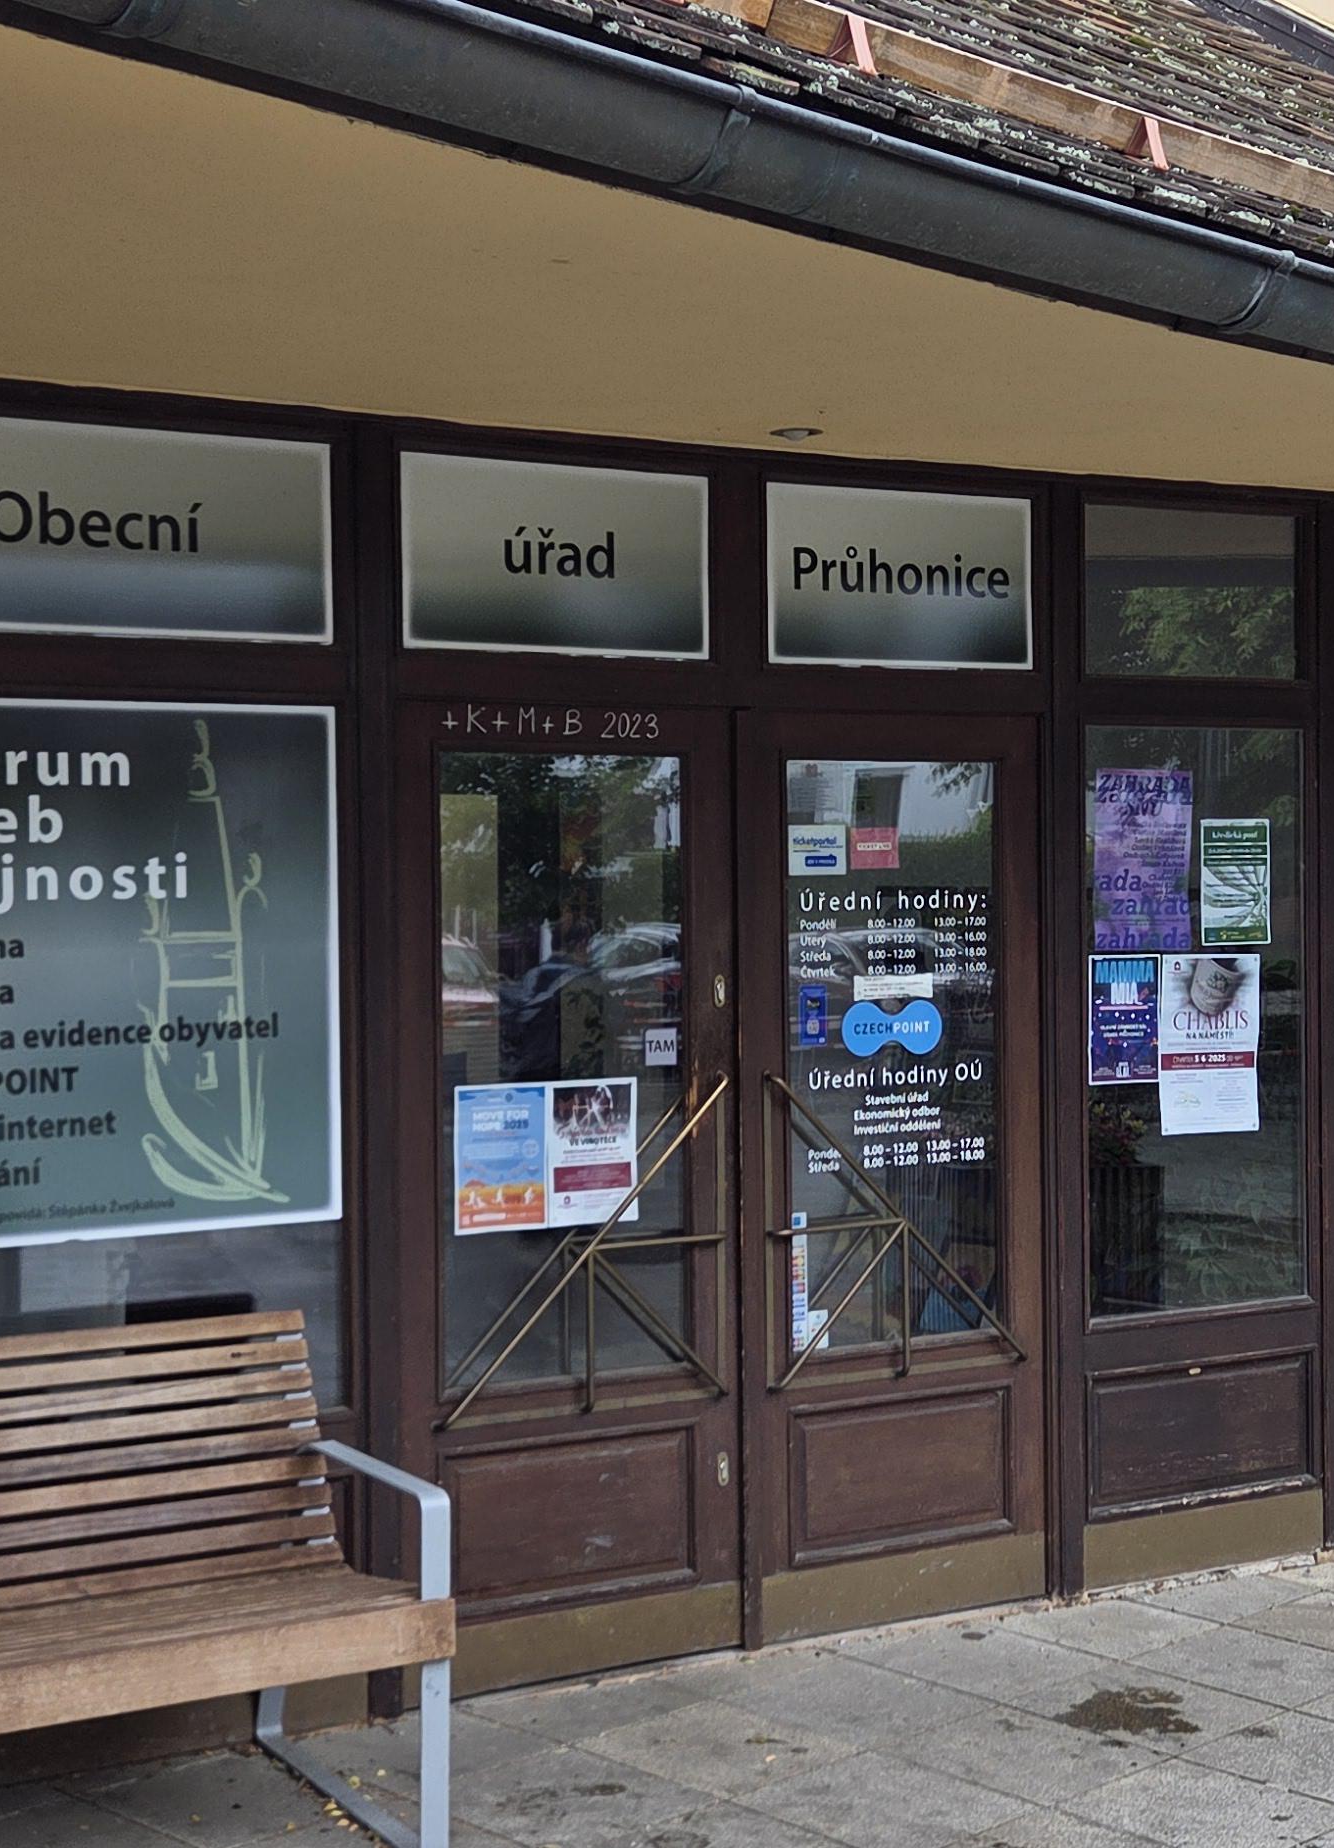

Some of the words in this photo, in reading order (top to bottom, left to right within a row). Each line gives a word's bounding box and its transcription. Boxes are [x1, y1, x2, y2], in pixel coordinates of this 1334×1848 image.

[503, 525, 617, 580] úřad
[792, 545, 1011, 599] Průhonice
[600, 711, 659, 739] 2023
[792, 836, 838, 847] ticketportal
[1095, 868, 1142, 892] ada
[799, 887, 882, 912] Úřední
[898, 888, 987, 913] hodiny:
[1095, 960, 1155, 984] MAMMA
[1110, 981, 1139, 1005] MIA
[0, 1029, 15, 1052] a
[23, 1020, 151, 1049] evidence
[159, 1013, 279, 1049] obyvatel
[1172, 1010, 1249, 1031] CHABLIS
[646, 1040, 675, 1054] TAM
[1186, 1031, 1197, 1040] NA
[808, 1067, 875, 1090] Úřední
[882, 1065, 948, 1087] hodiny
[954, 1058, 982, 1081] OÚ
[865, 1092, 906, 1105] Stavební
[907, 1090, 929, 1103] úřad
[472, 1111, 504, 1121] MOVE
[506, 1109, 529, 1120] FOR
[853, 1107, 910, 1121] Ekonomický
[912, 1106, 940, 1118] odbor
[853, 1122, 898, 1136] Investiční
[900, 1118, 941, 1133] oddělení
